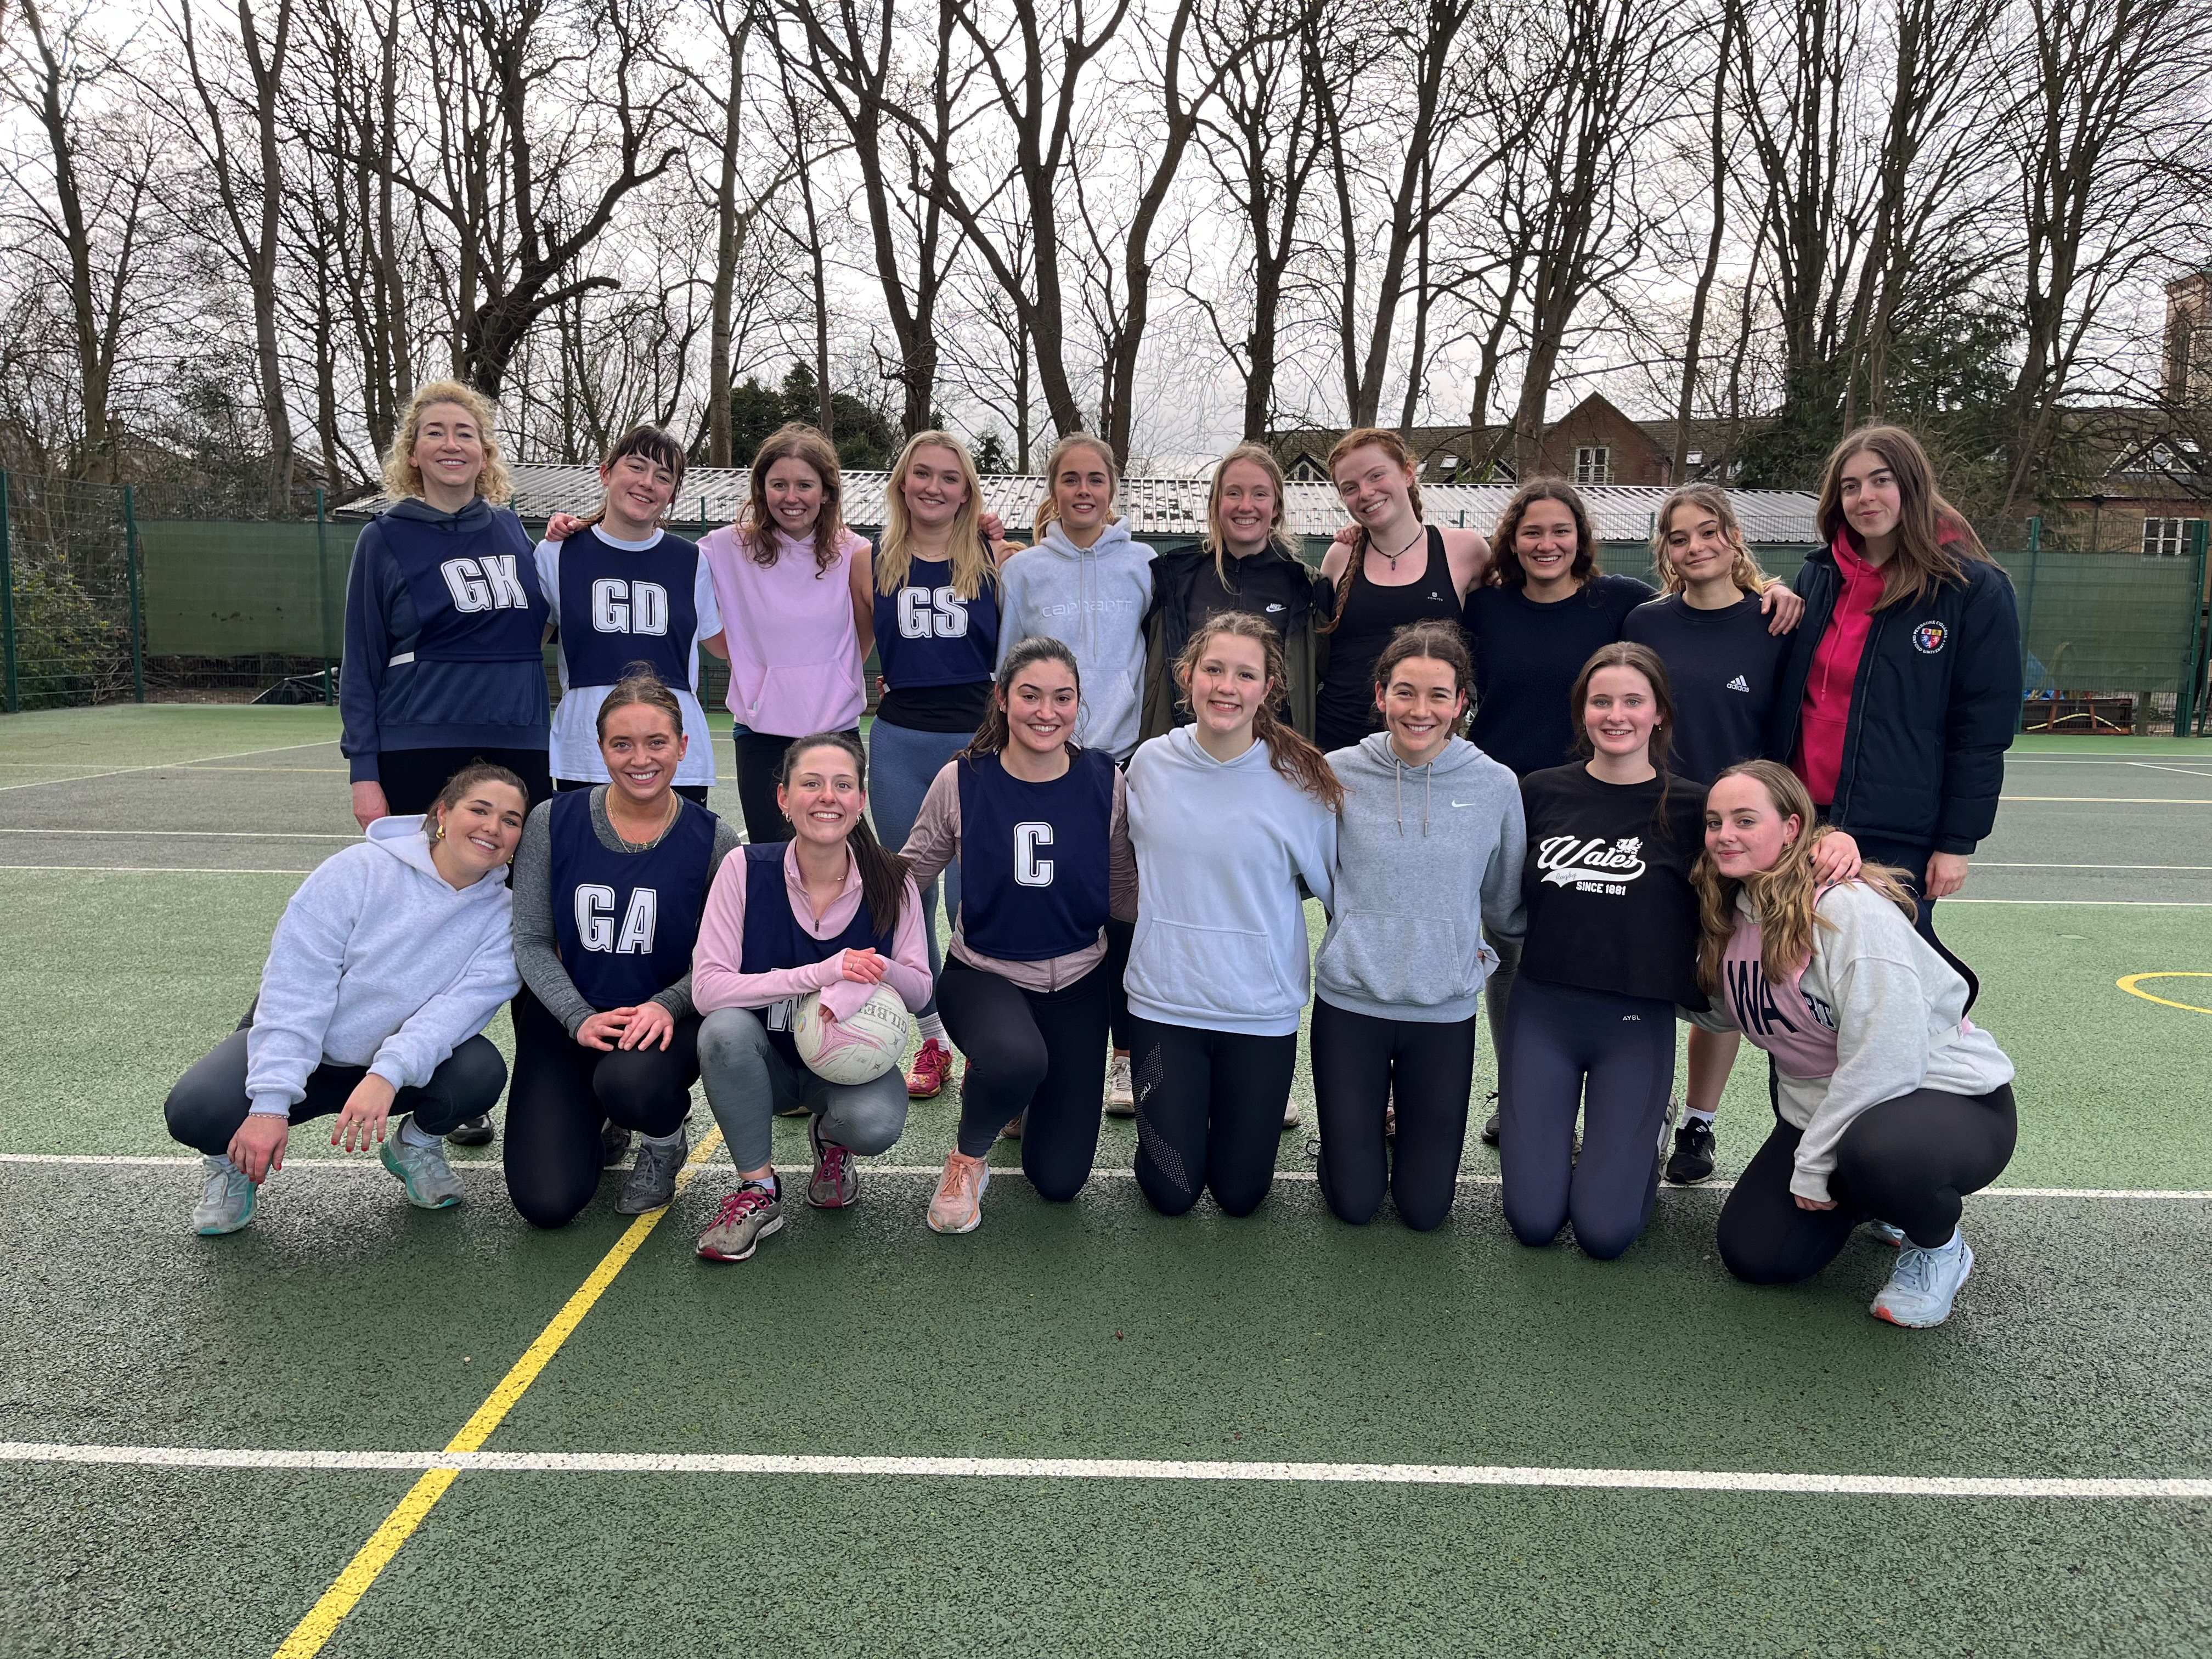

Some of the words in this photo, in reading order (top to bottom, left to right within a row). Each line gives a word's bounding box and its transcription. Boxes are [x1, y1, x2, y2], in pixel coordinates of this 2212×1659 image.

[441, 555, 528, 613] GK
[592, 578, 668, 636] GD
[1042, 599, 1133, 618] carhartt
[897, 586, 968, 639] GS
[1726, 682, 1750, 692] adidas
[1013, 821, 1054, 887] C
[1537, 835, 1640, 871] Wales
[1576, 881, 1604, 894] SINCE
[1605, 884, 1627, 896] 1881
[574, 883, 657, 955] GA
[1727, 961, 1800, 1035] WA
